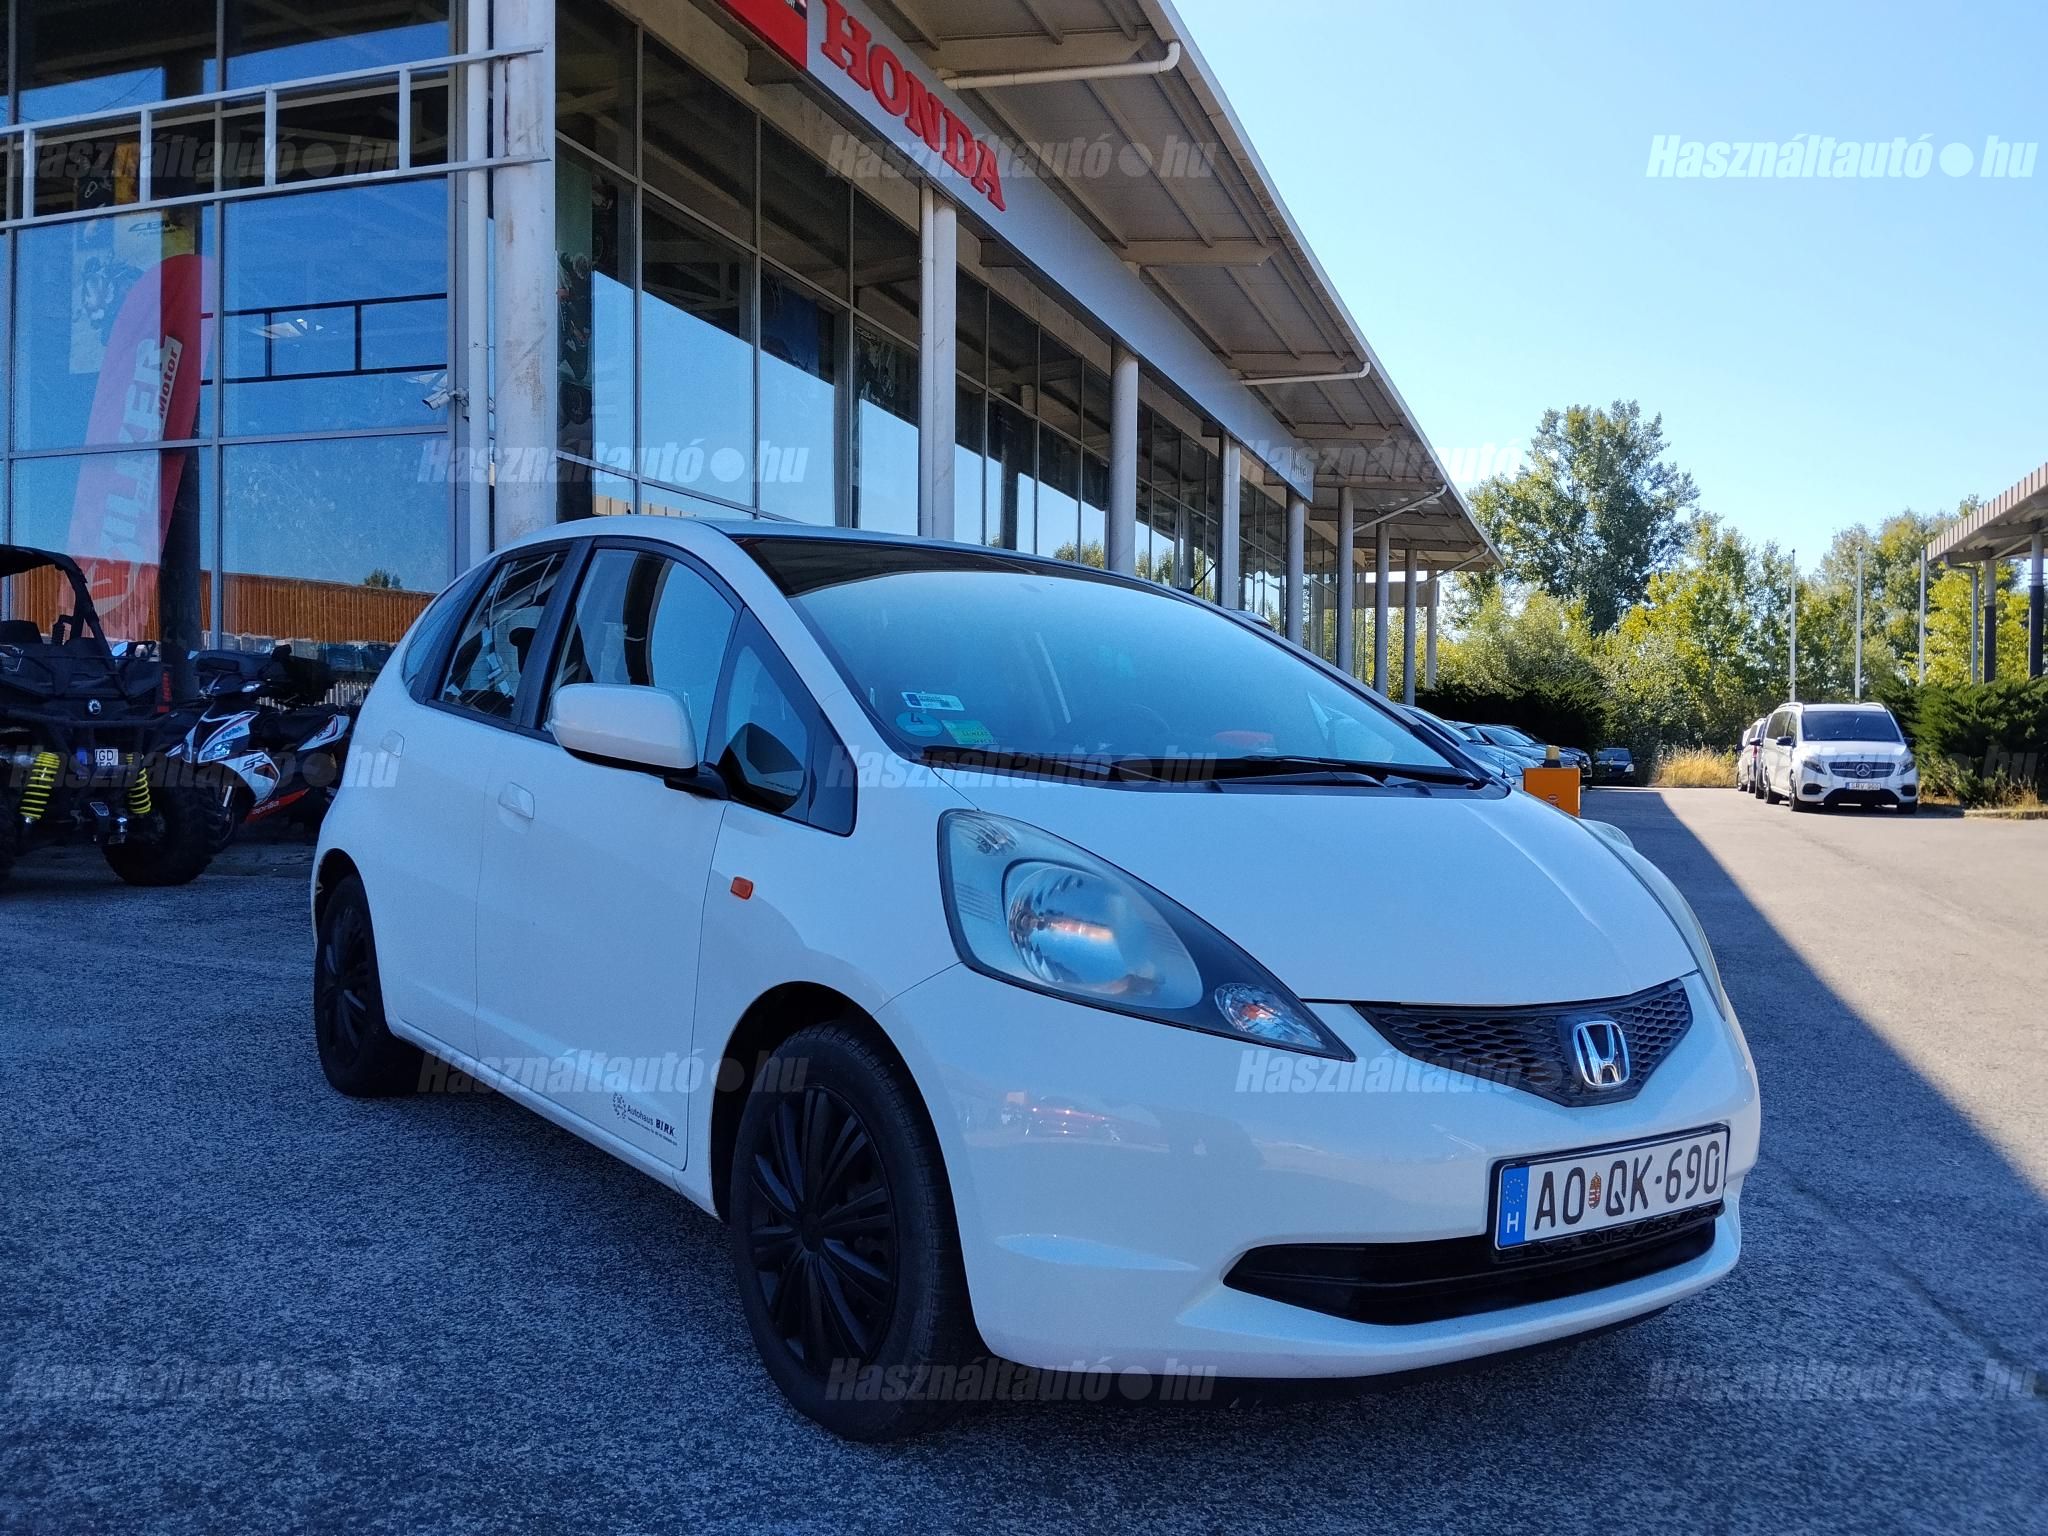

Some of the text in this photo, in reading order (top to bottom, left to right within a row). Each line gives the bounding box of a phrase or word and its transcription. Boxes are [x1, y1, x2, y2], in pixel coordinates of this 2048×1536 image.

[821, 0, 1007, 212] HONDA
[627, 1104, 654, 1126] Autohaus
[655, 1118, 676, 1137] BIRK
[1505, 1211, 1520, 1234] H
